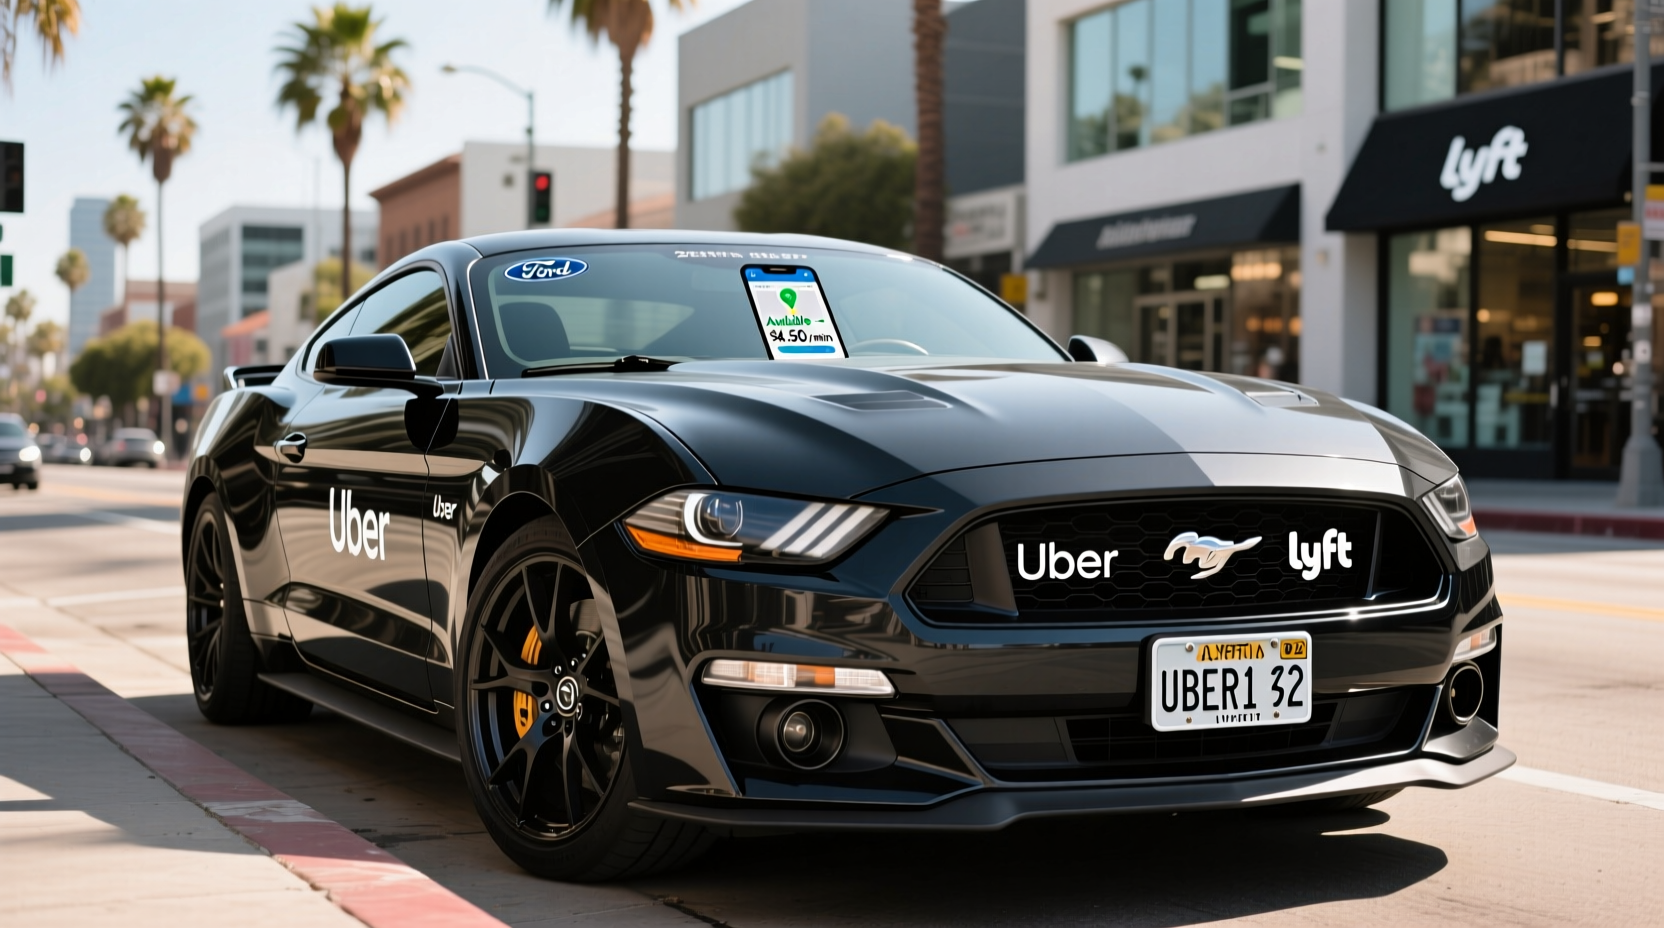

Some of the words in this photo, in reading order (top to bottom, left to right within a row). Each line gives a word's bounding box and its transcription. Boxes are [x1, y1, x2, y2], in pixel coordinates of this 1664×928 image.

[522, 260, 572, 279] Ford
[329, 487, 390, 561] Uber
[1017, 541, 1119, 581] Uber
[1289, 528, 1353, 581] lyft
[1161, 665, 1257, 713] UBER1
[1271, 664, 1304, 708] 32
